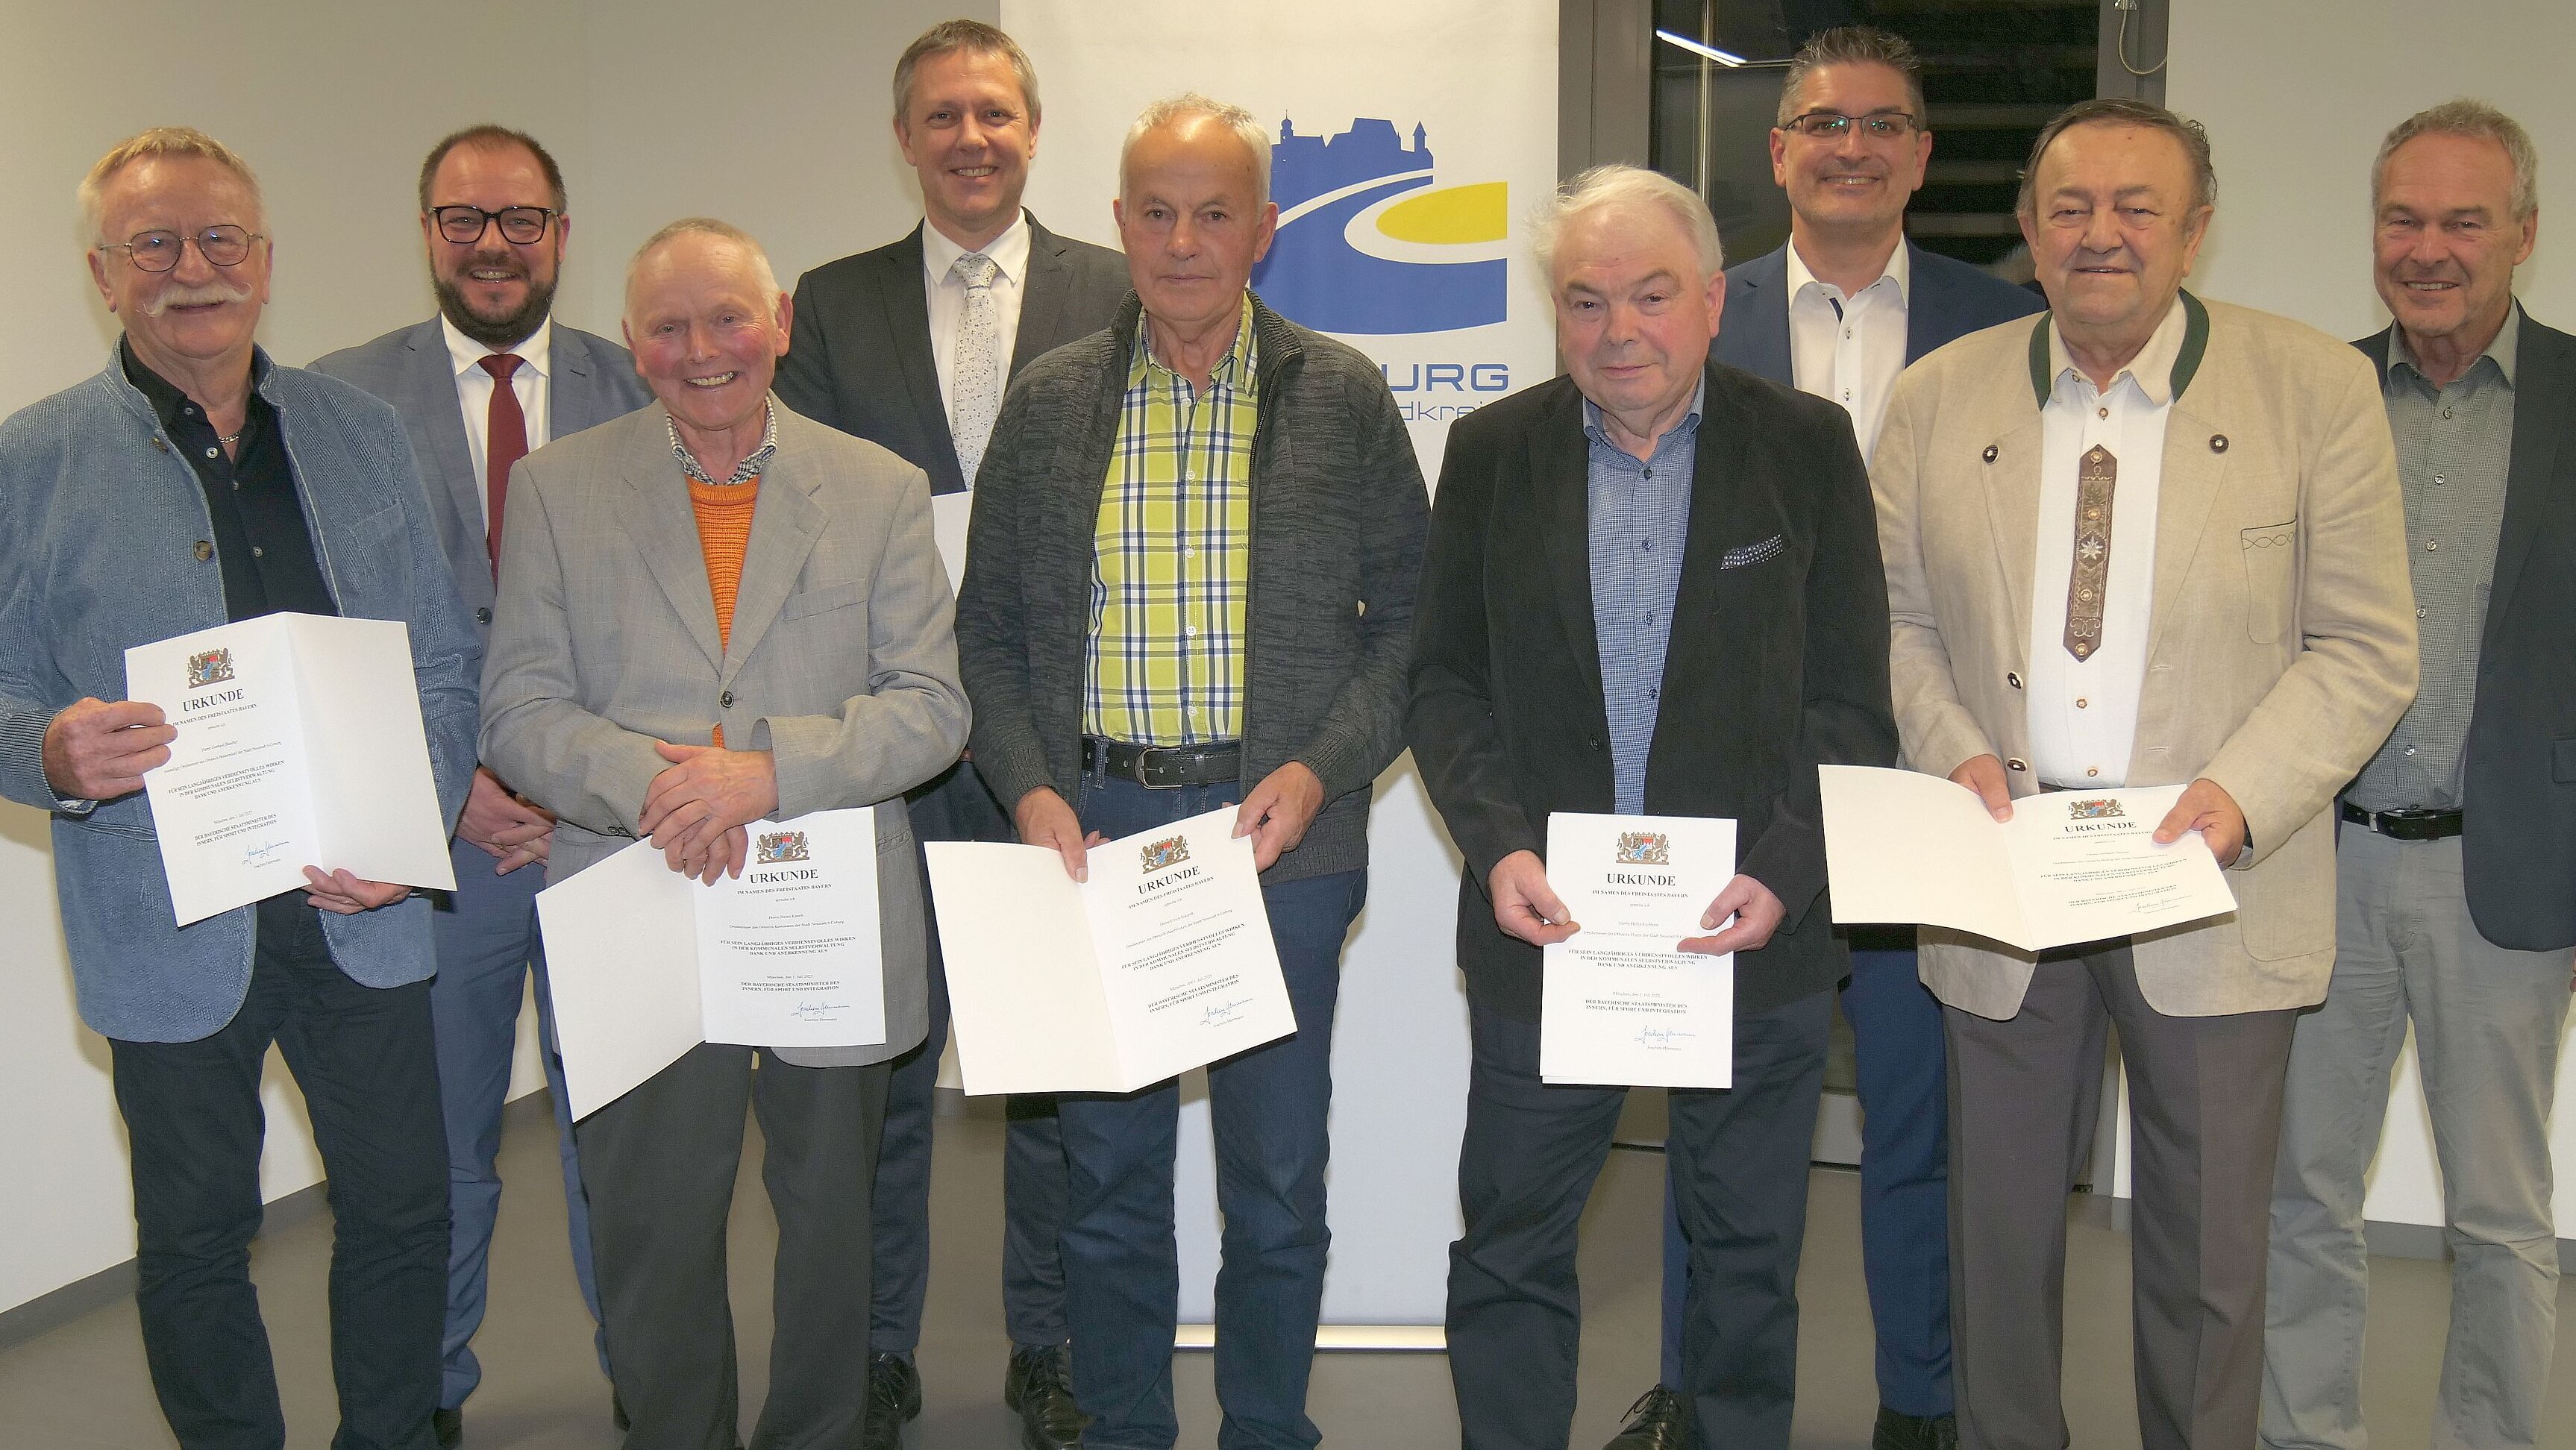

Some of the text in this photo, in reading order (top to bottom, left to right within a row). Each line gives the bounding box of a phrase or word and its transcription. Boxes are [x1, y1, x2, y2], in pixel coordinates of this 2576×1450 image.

[1382, 364, 1508, 392] URG
[183, 689, 243, 712] URKUNDE
[2064, 821, 2137, 832] URKUNDE
[750, 869, 818, 884] URKUNDE
[1138, 865, 1200, 895] URKUNDE
[1607, 873, 1675, 886] URKUNDE
